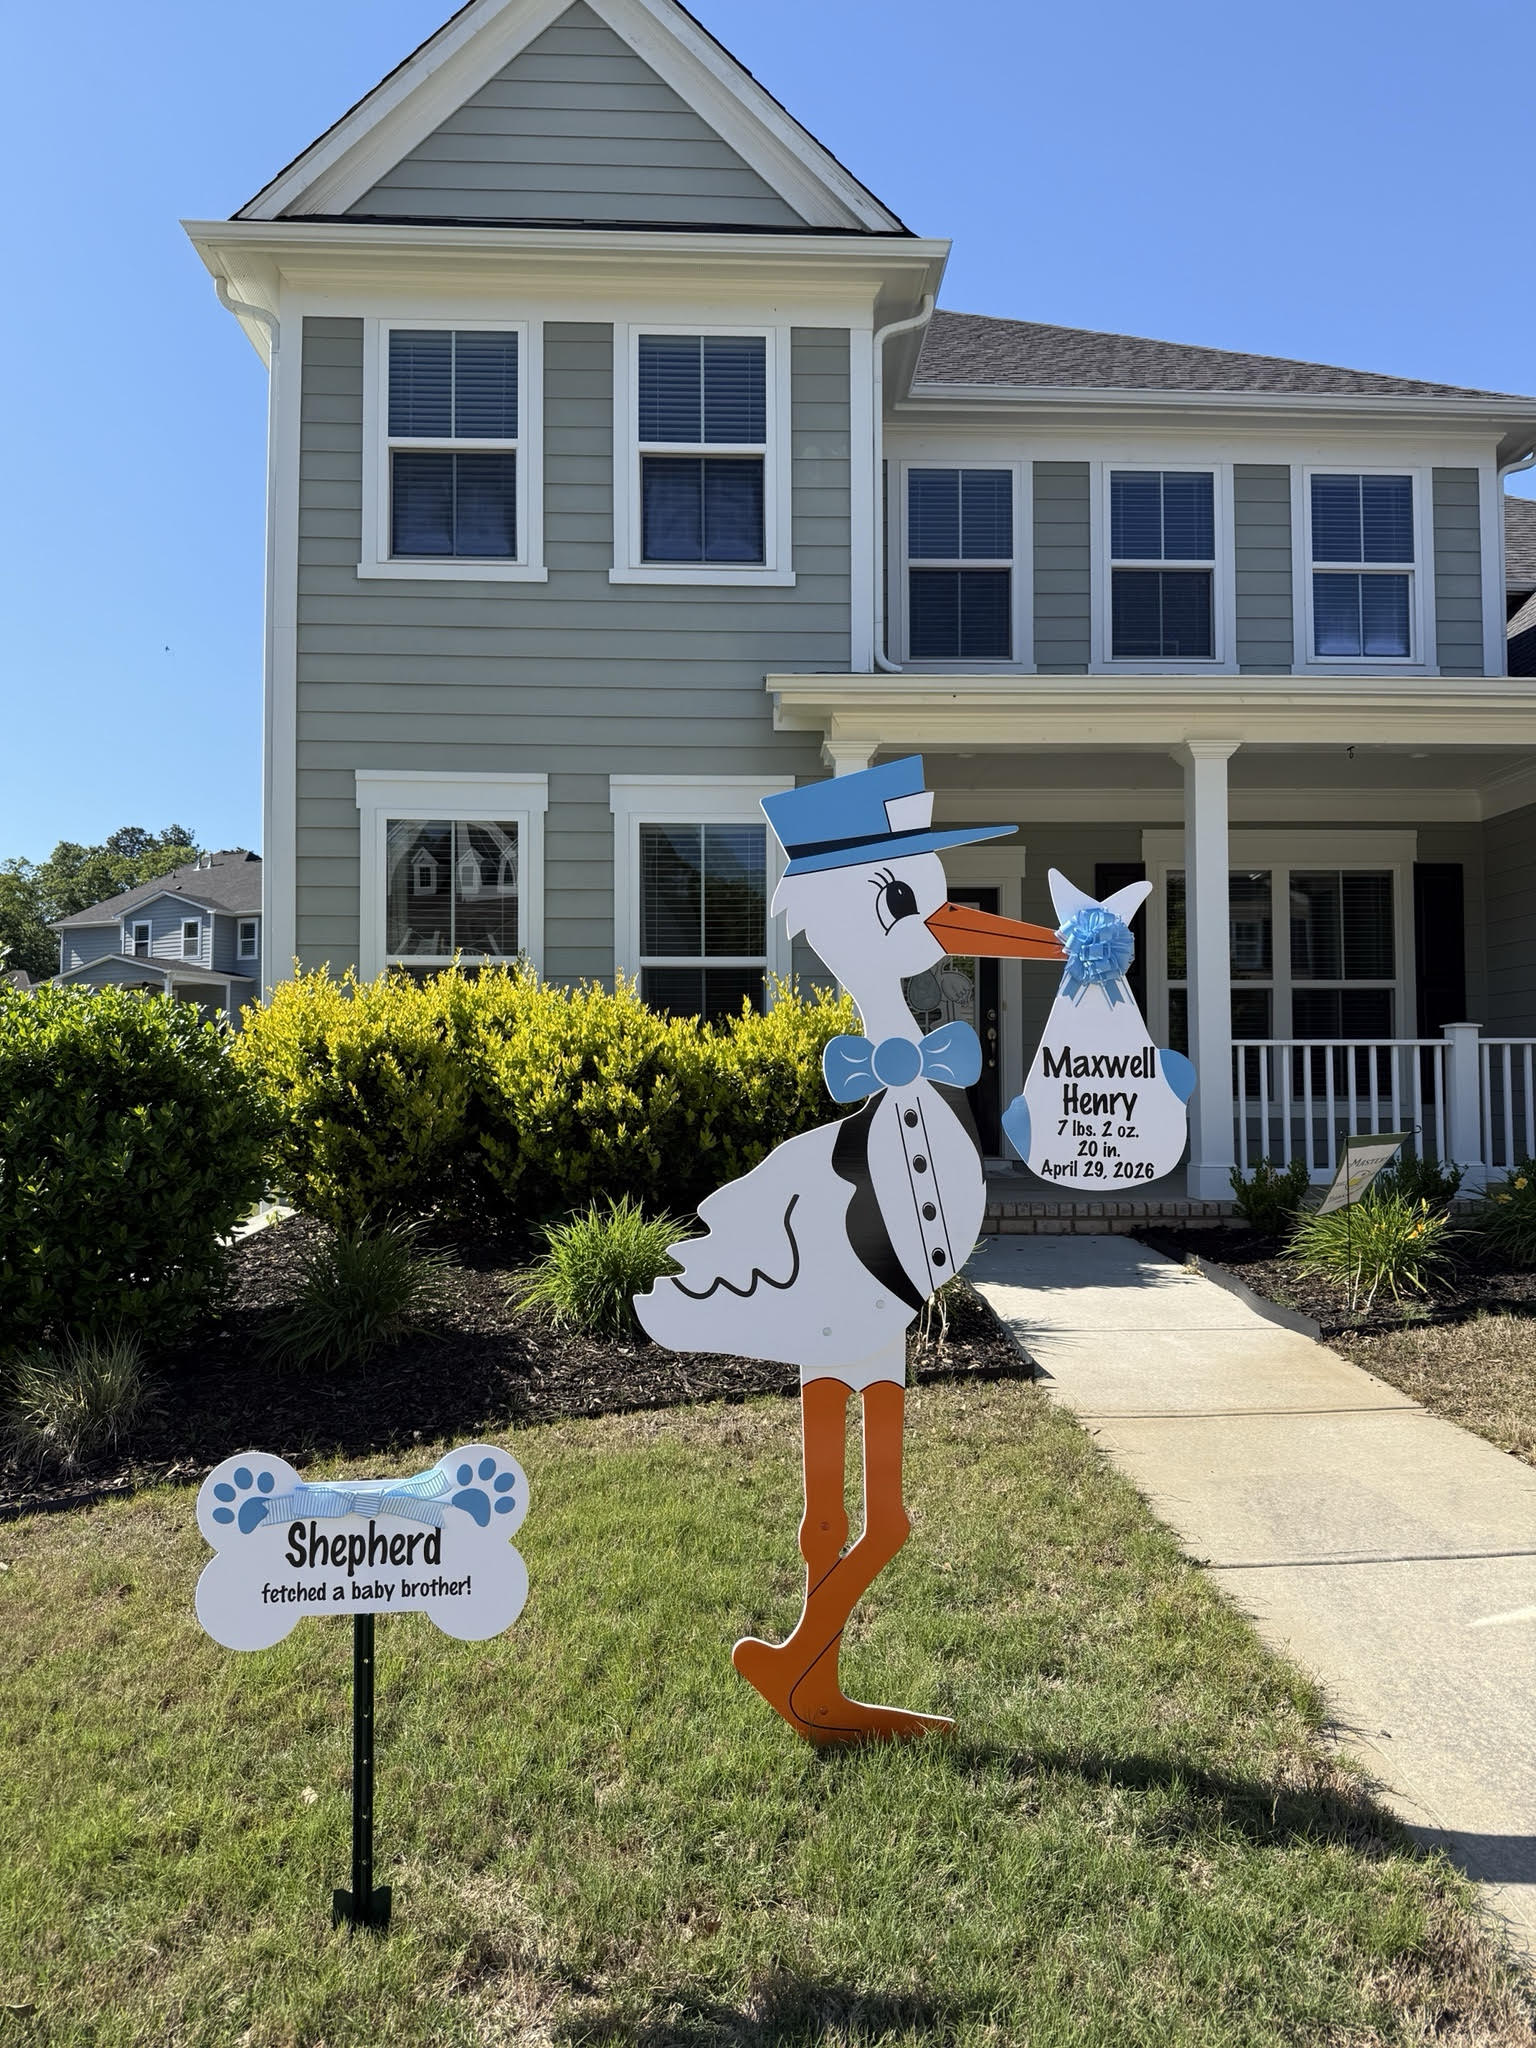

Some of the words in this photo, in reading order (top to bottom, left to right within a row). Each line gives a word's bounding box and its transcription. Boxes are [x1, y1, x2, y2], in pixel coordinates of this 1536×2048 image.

[1042, 1045, 1156, 1079] Maxwell
[1062, 1083, 1138, 1121] Henry
[1057, 1119, 1068, 1136] 7
[1072, 1119, 1097, 1137] lbs.
[1101, 1120, 1113, 1138] 2
[1117, 1126, 1140, 1138] oz.
[1077, 1140, 1098, 1158] 20
[1103, 1141, 1121, 1158] in.
[1041, 1159, 1078, 1179] April
[1083, 1160, 1107, 1180] 29,
[1113, 1162, 1155, 1179] 2026
[285, 1520, 442, 1577] Shepherd
[261, 1581, 327, 1604] fetched
[332, 1585, 345, 1601] a
[351, 1579, 396, 1603] baby
[401, 1575, 472, 1598] brother!
